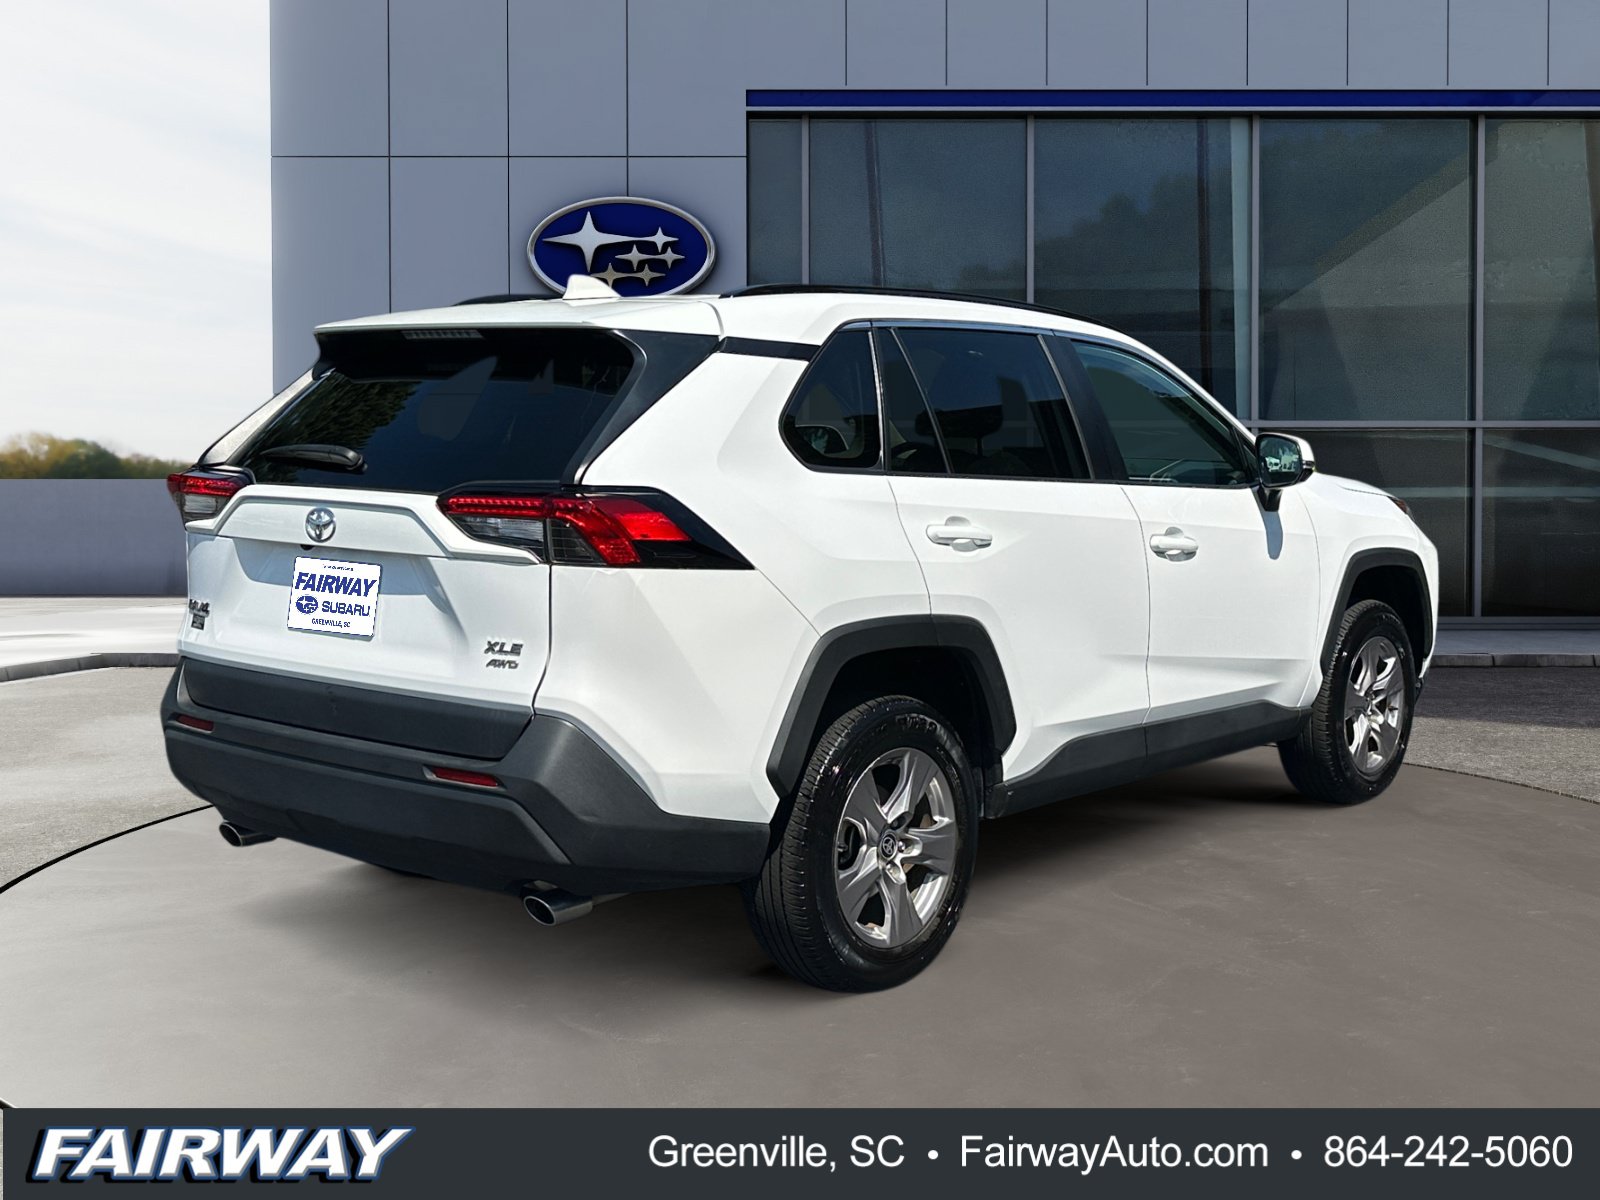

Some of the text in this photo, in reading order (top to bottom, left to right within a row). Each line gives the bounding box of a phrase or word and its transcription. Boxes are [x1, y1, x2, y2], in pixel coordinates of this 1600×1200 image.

[295, 572, 377, 597] FAIRWAY
[322, 601, 370, 616] SUBARU
[484, 641, 523, 656] XLE
